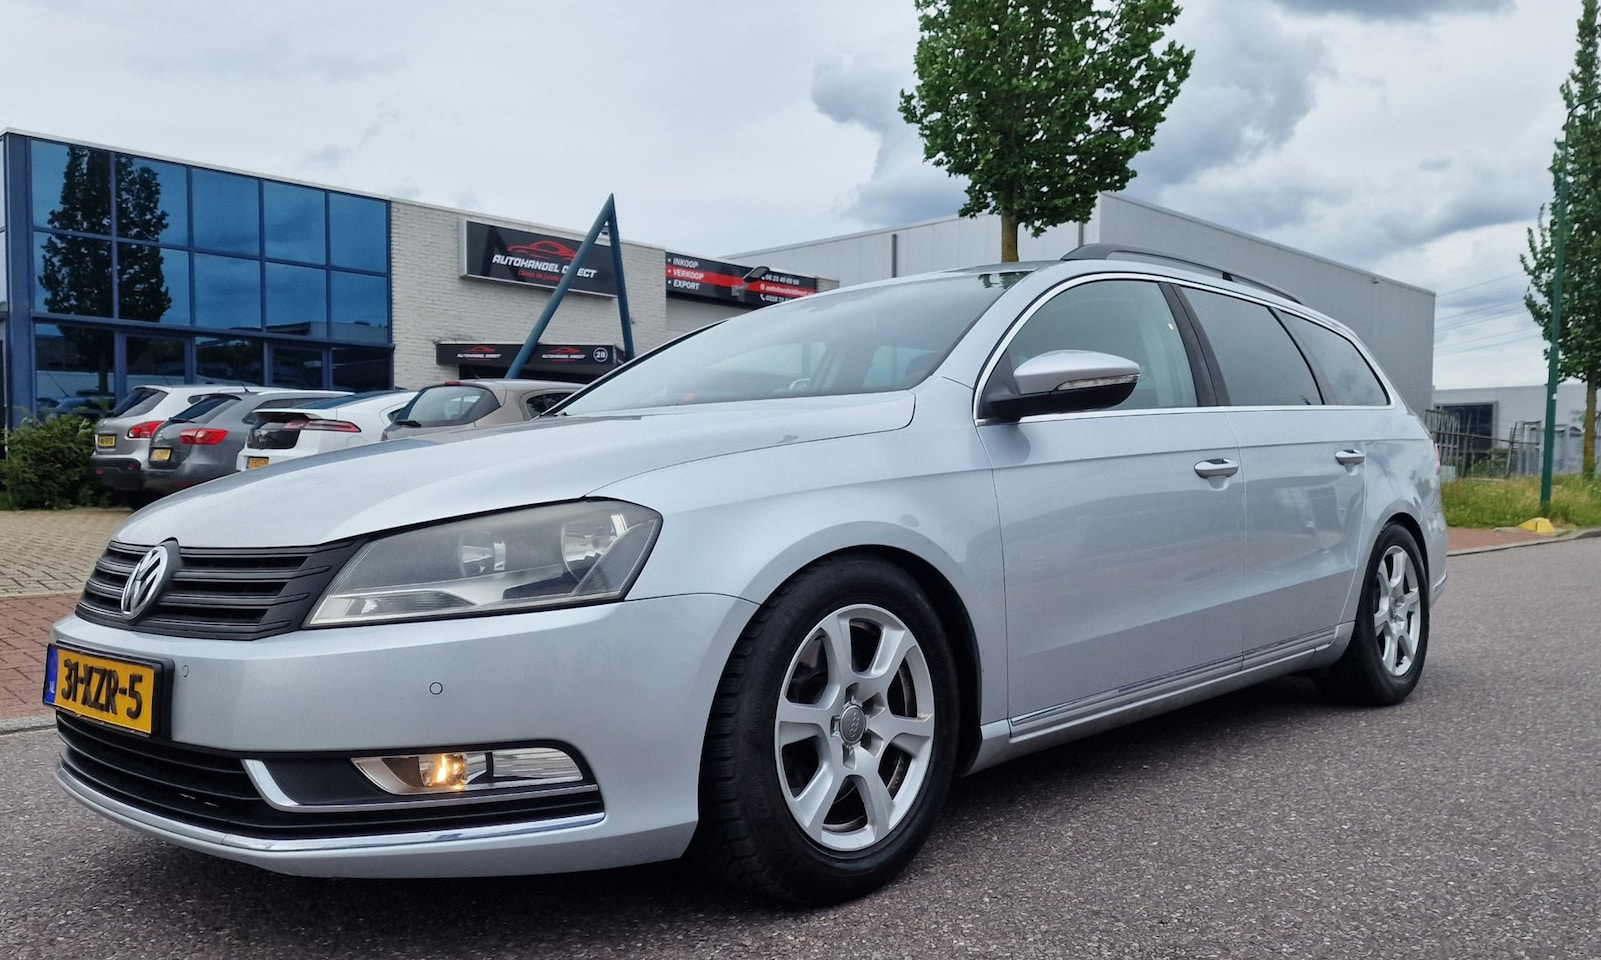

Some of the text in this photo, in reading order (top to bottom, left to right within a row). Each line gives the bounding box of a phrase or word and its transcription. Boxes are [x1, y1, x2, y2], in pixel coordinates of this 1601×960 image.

[492, 254, 597, 279] AUTOHANDEL DECT
[673, 258, 698, 268] INKOOP
[673, 268, 704, 280] VERKOOP
[673, 279, 699, 290] EXPORT
[596, 350, 605, 358] 28
[61, 658, 143, 720] 31-KZR-5
